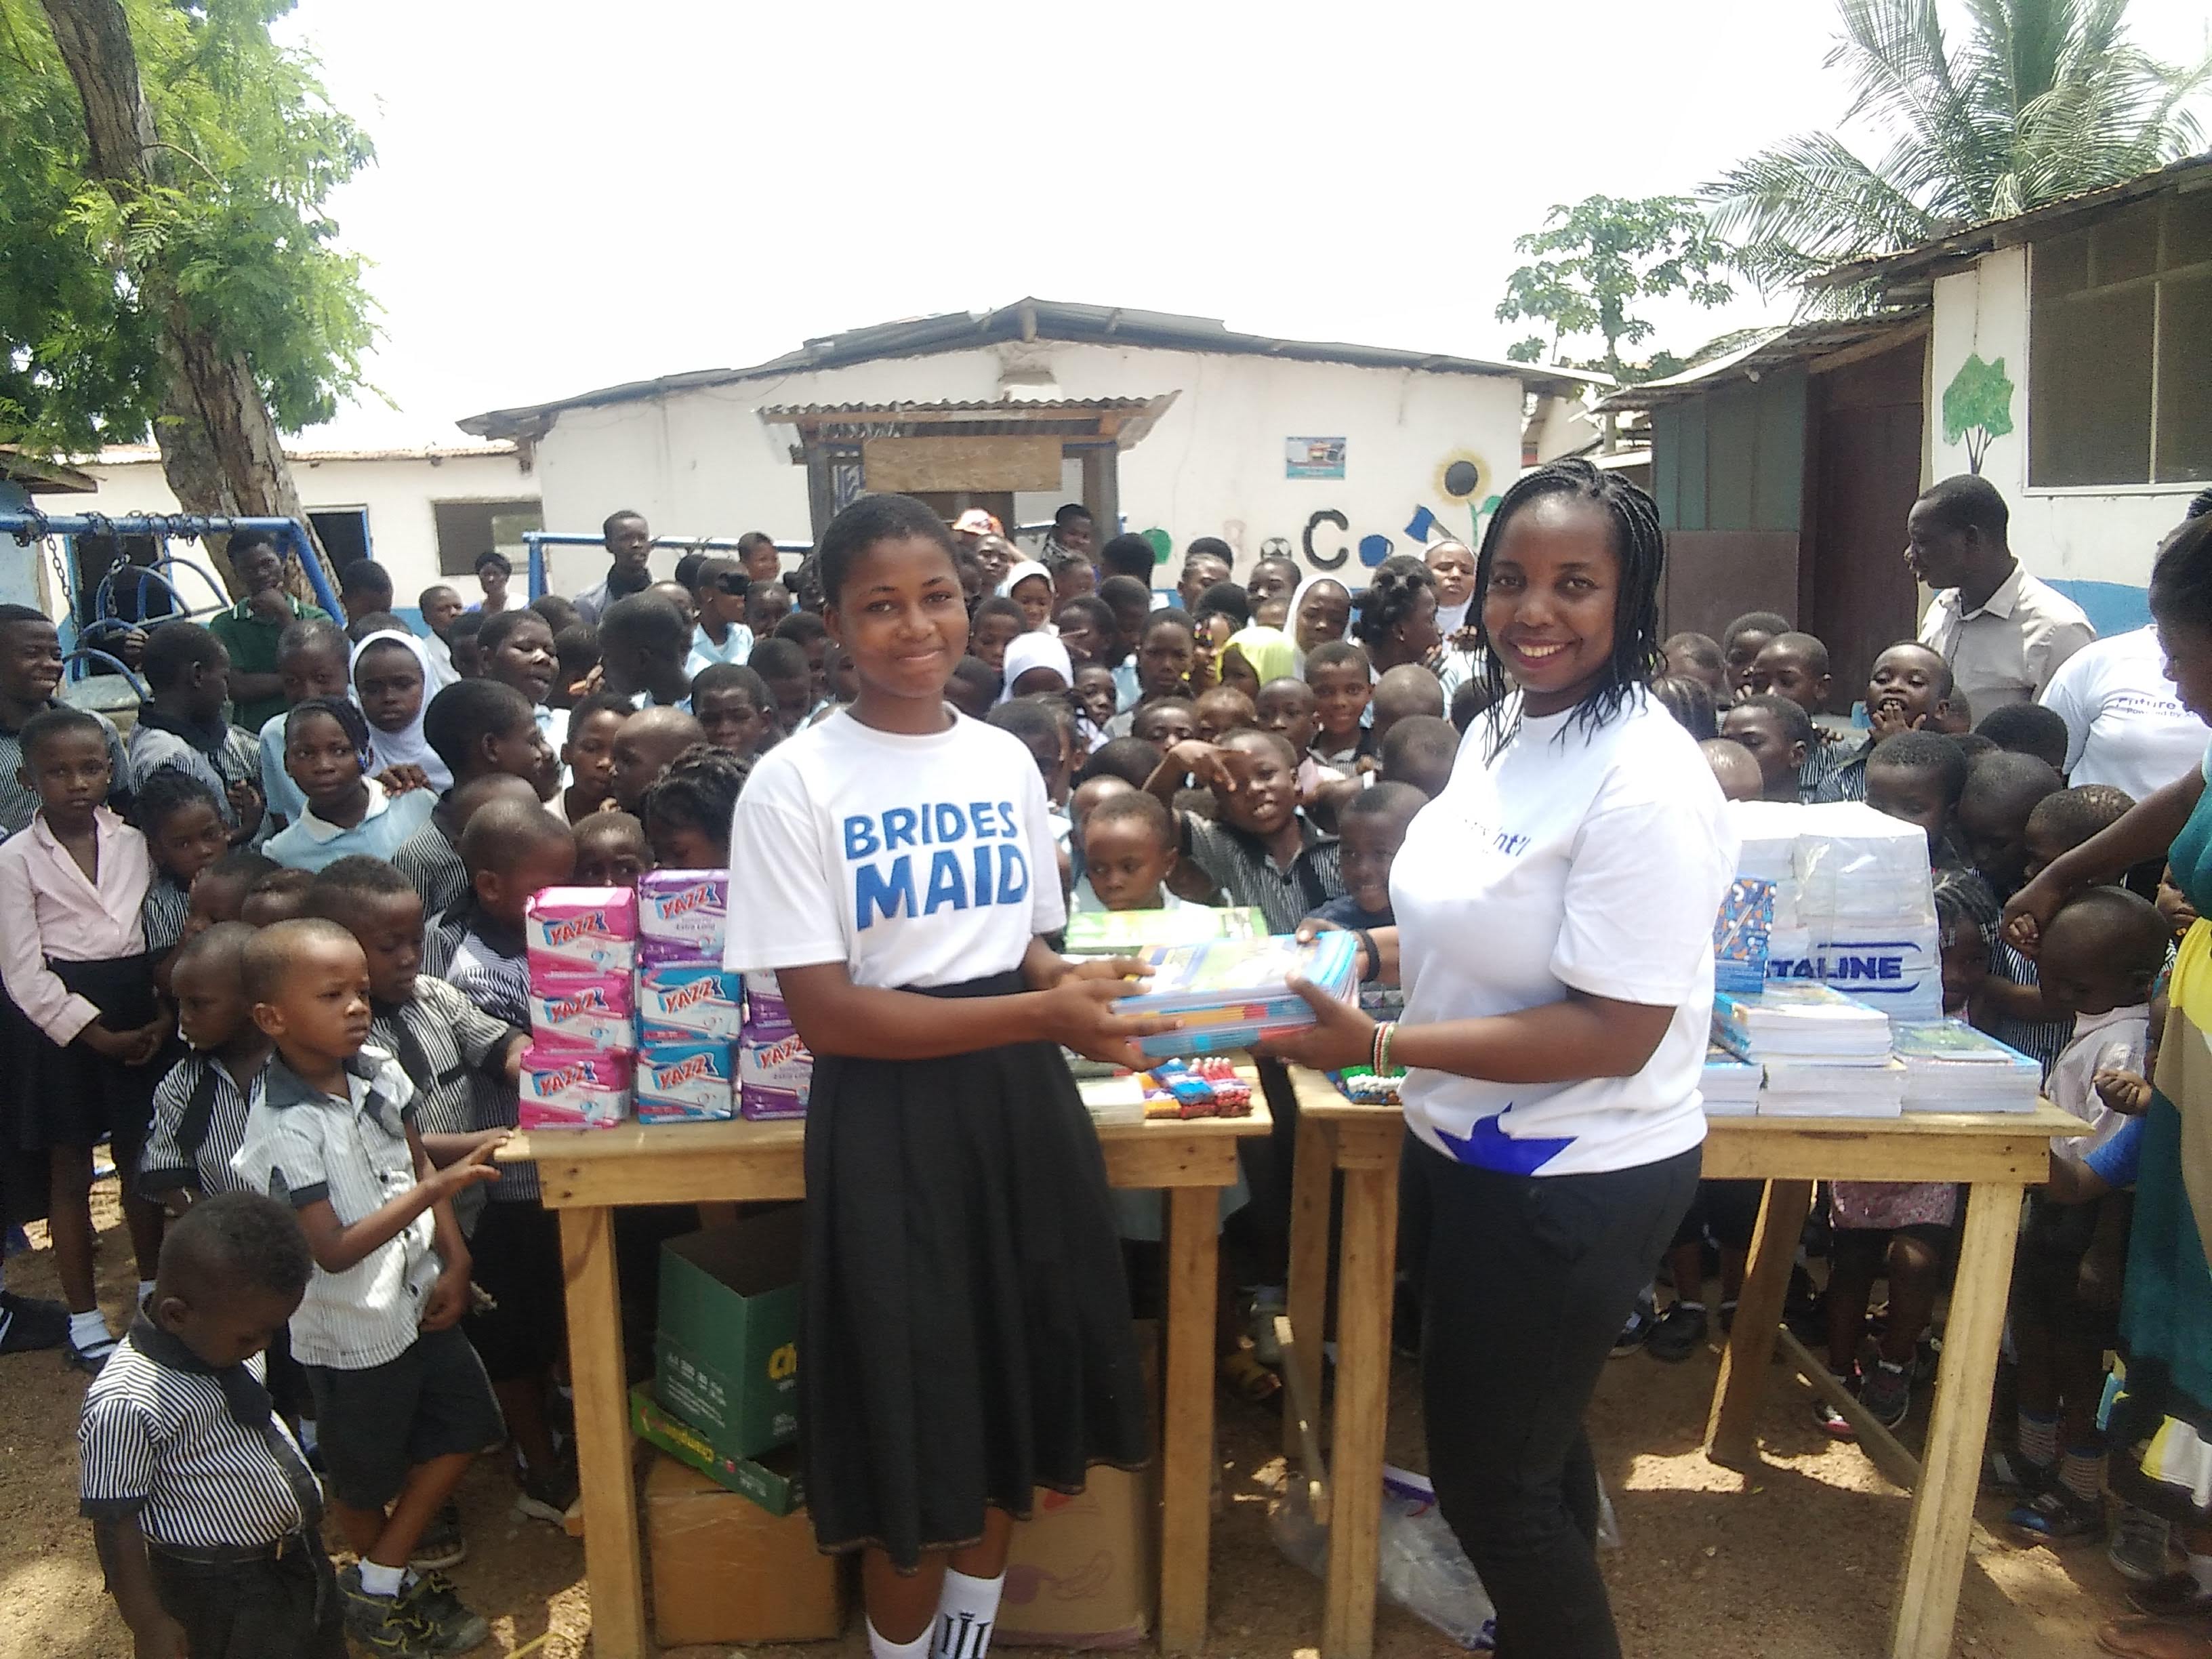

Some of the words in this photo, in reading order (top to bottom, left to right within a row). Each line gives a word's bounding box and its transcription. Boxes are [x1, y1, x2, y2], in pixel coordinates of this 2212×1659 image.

[1303, 509, 1349, 571] C
[844, 801, 1017, 860] BRIDES
[661, 883, 709, 920] YAZZ
[856, 843, 1029, 931] MAID
[550, 912, 598, 946] YAZZ
[1766, 957, 1903, 979] TALINE
[550, 989, 596, 1024] YAZZ
[665, 979, 714, 1015] YAZZ
[539, 1062, 586, 1097] YAZZ
[657, 1054, 709, 1090] YAZZ
